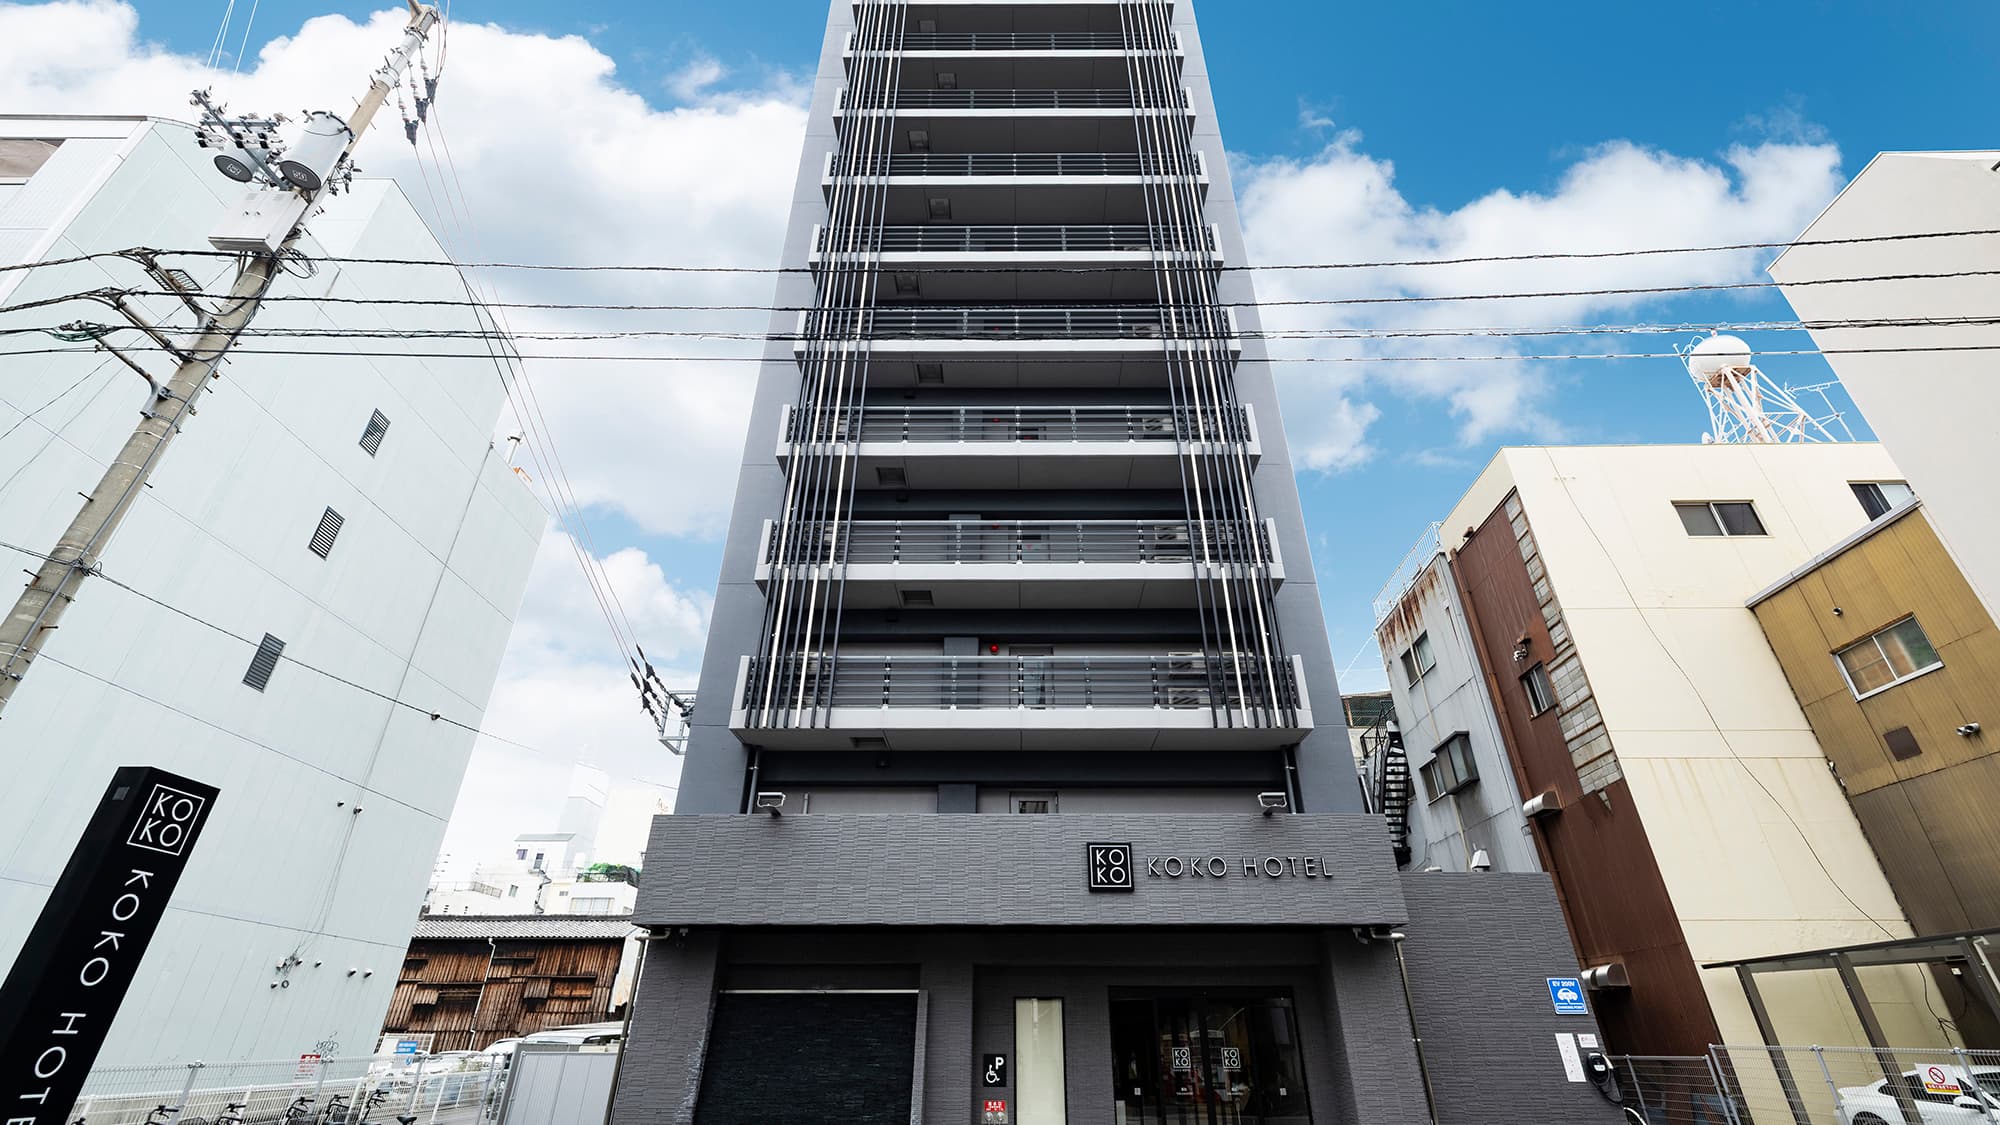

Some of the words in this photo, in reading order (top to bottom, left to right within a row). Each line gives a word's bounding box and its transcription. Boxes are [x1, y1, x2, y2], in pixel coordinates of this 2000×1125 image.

[152, 792, 194, 821] KO
[139, 818, 182, 847] KO
[1096, 849, 1125, 865] KO
[1147, 856, 1227, 877] KOKO
[1242, 856, 1333, 877] HOTEL
[1097, 867, 1126, 883] KO
[80, 869, 154, 986] KOKO
[995, 1056, 1005, 1070] P
[1175, 1058, 1189, 1066] KO
[1225, 1058, 1238, 1066] KO
